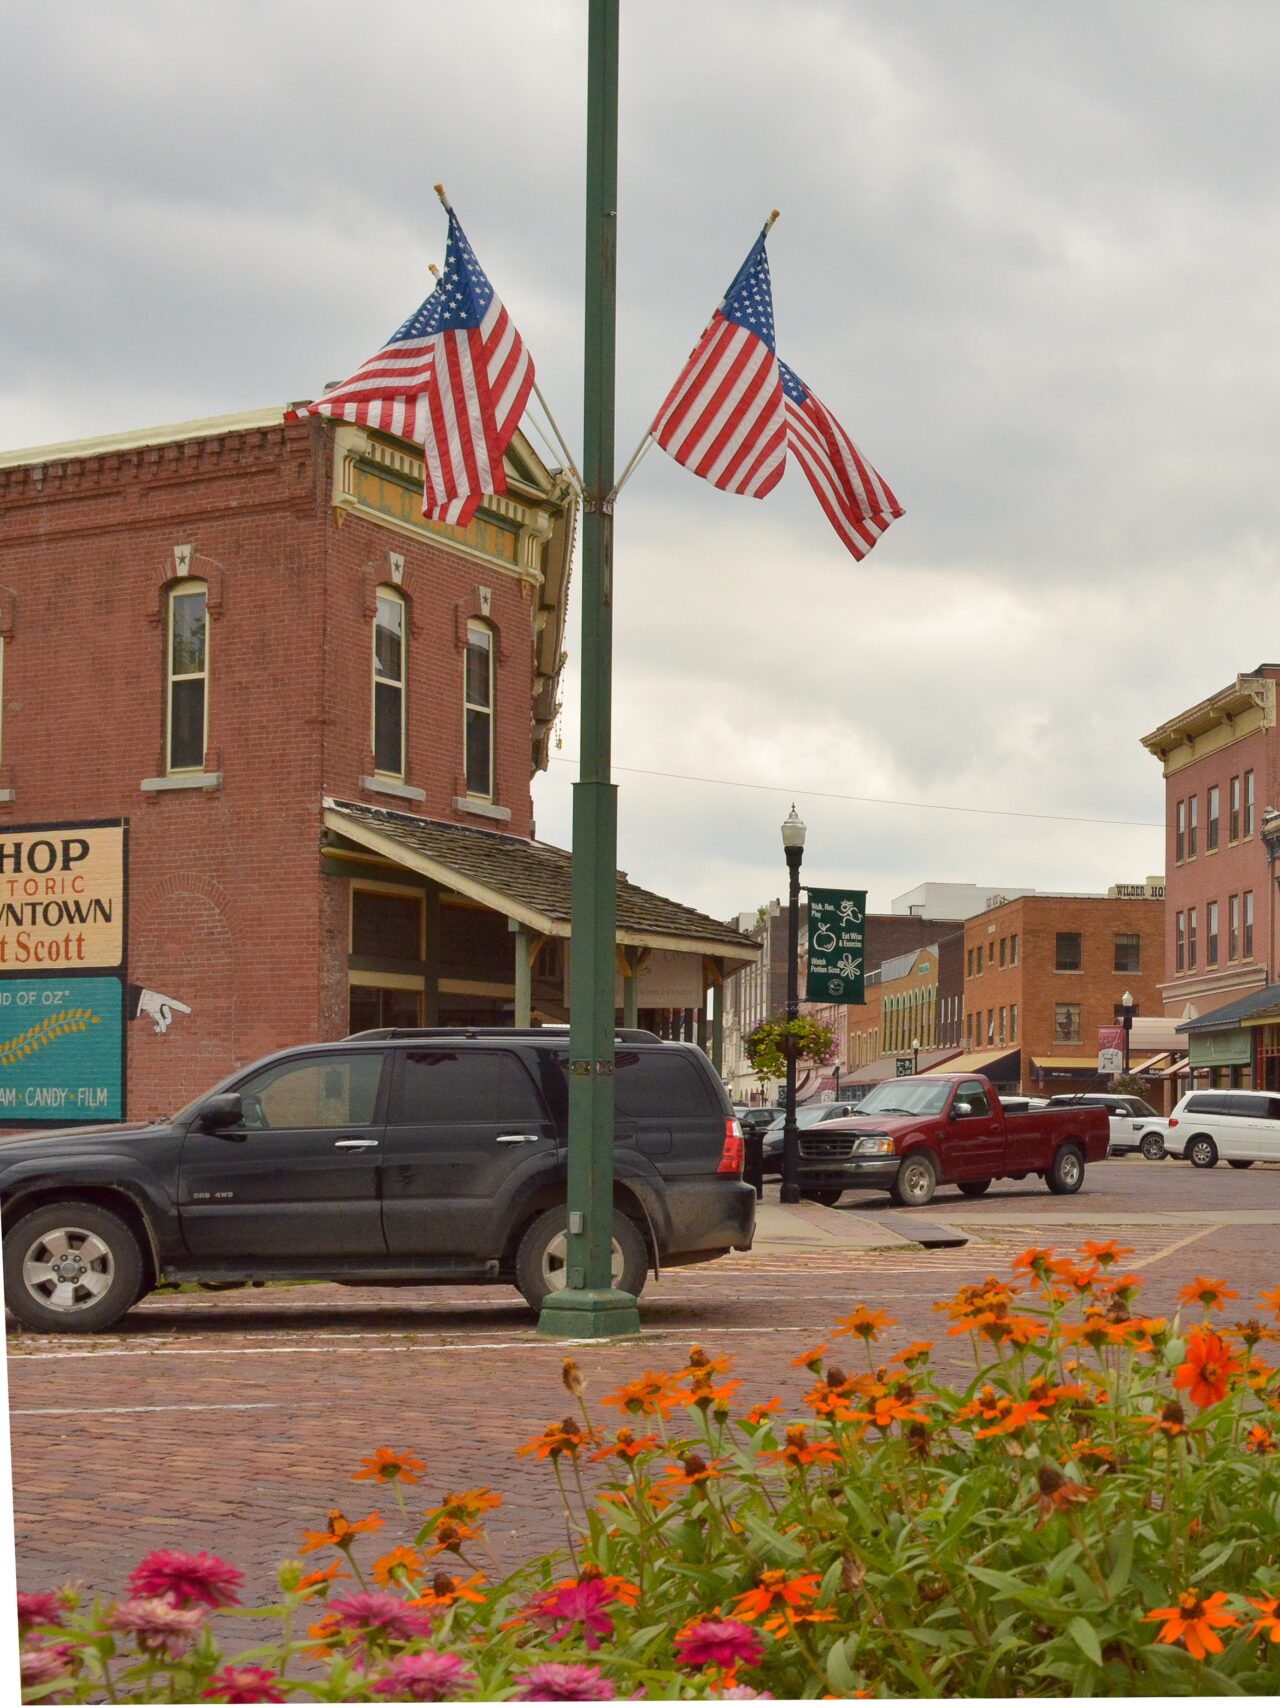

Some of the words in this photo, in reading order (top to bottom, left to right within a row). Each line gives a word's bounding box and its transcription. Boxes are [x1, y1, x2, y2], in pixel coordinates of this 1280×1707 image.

[1116, 885, 1145, 897] WILDER
[811, 909, 822, 919] Play
[842, 931, 851, 940] Eat
[15, 931, 85, 963] Scott
[810, 957, 827, 966] Watch
[17, 991, 36, 1005] OF
[25, 1087, 69, 1107] CANDY
[78, 1087, 108, 1107] FILM
